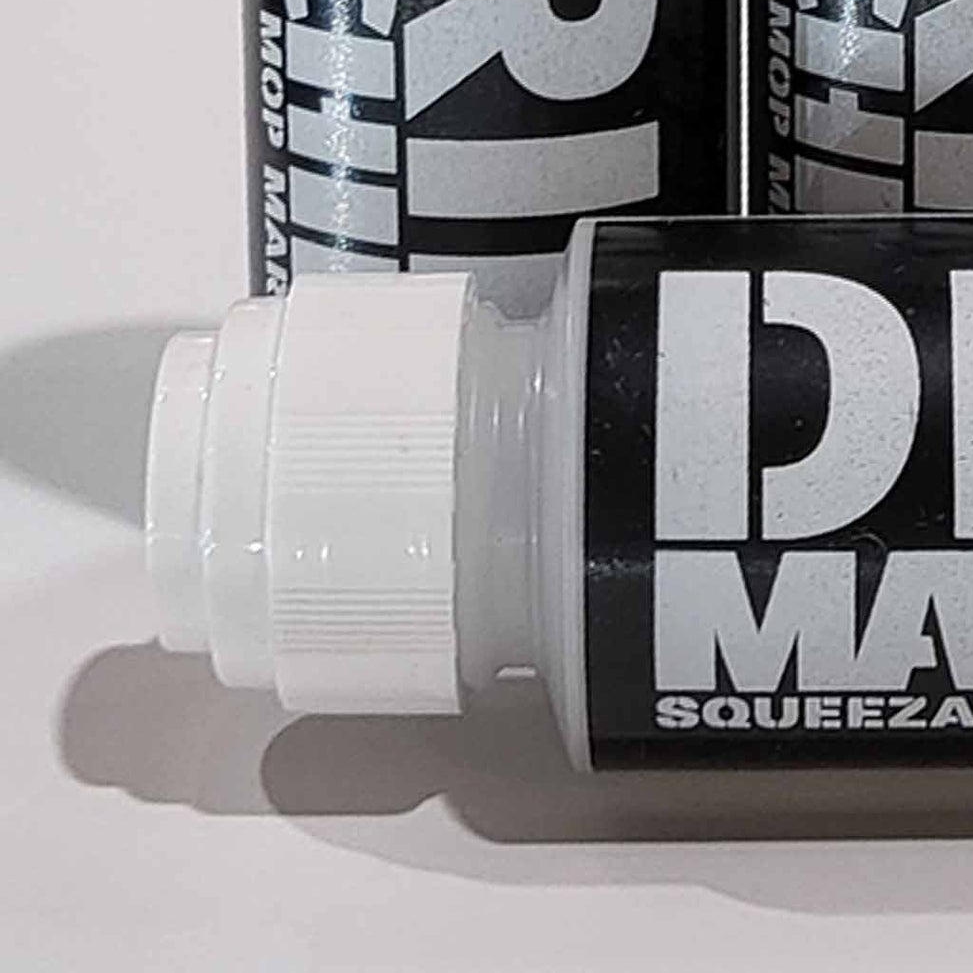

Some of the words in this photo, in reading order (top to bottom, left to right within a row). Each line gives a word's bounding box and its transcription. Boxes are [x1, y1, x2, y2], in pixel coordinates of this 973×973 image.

[259, 10, 285, 149] MOP
[768, 0, 791, 137] MOP
[262, 164, 290, 296] MAR
